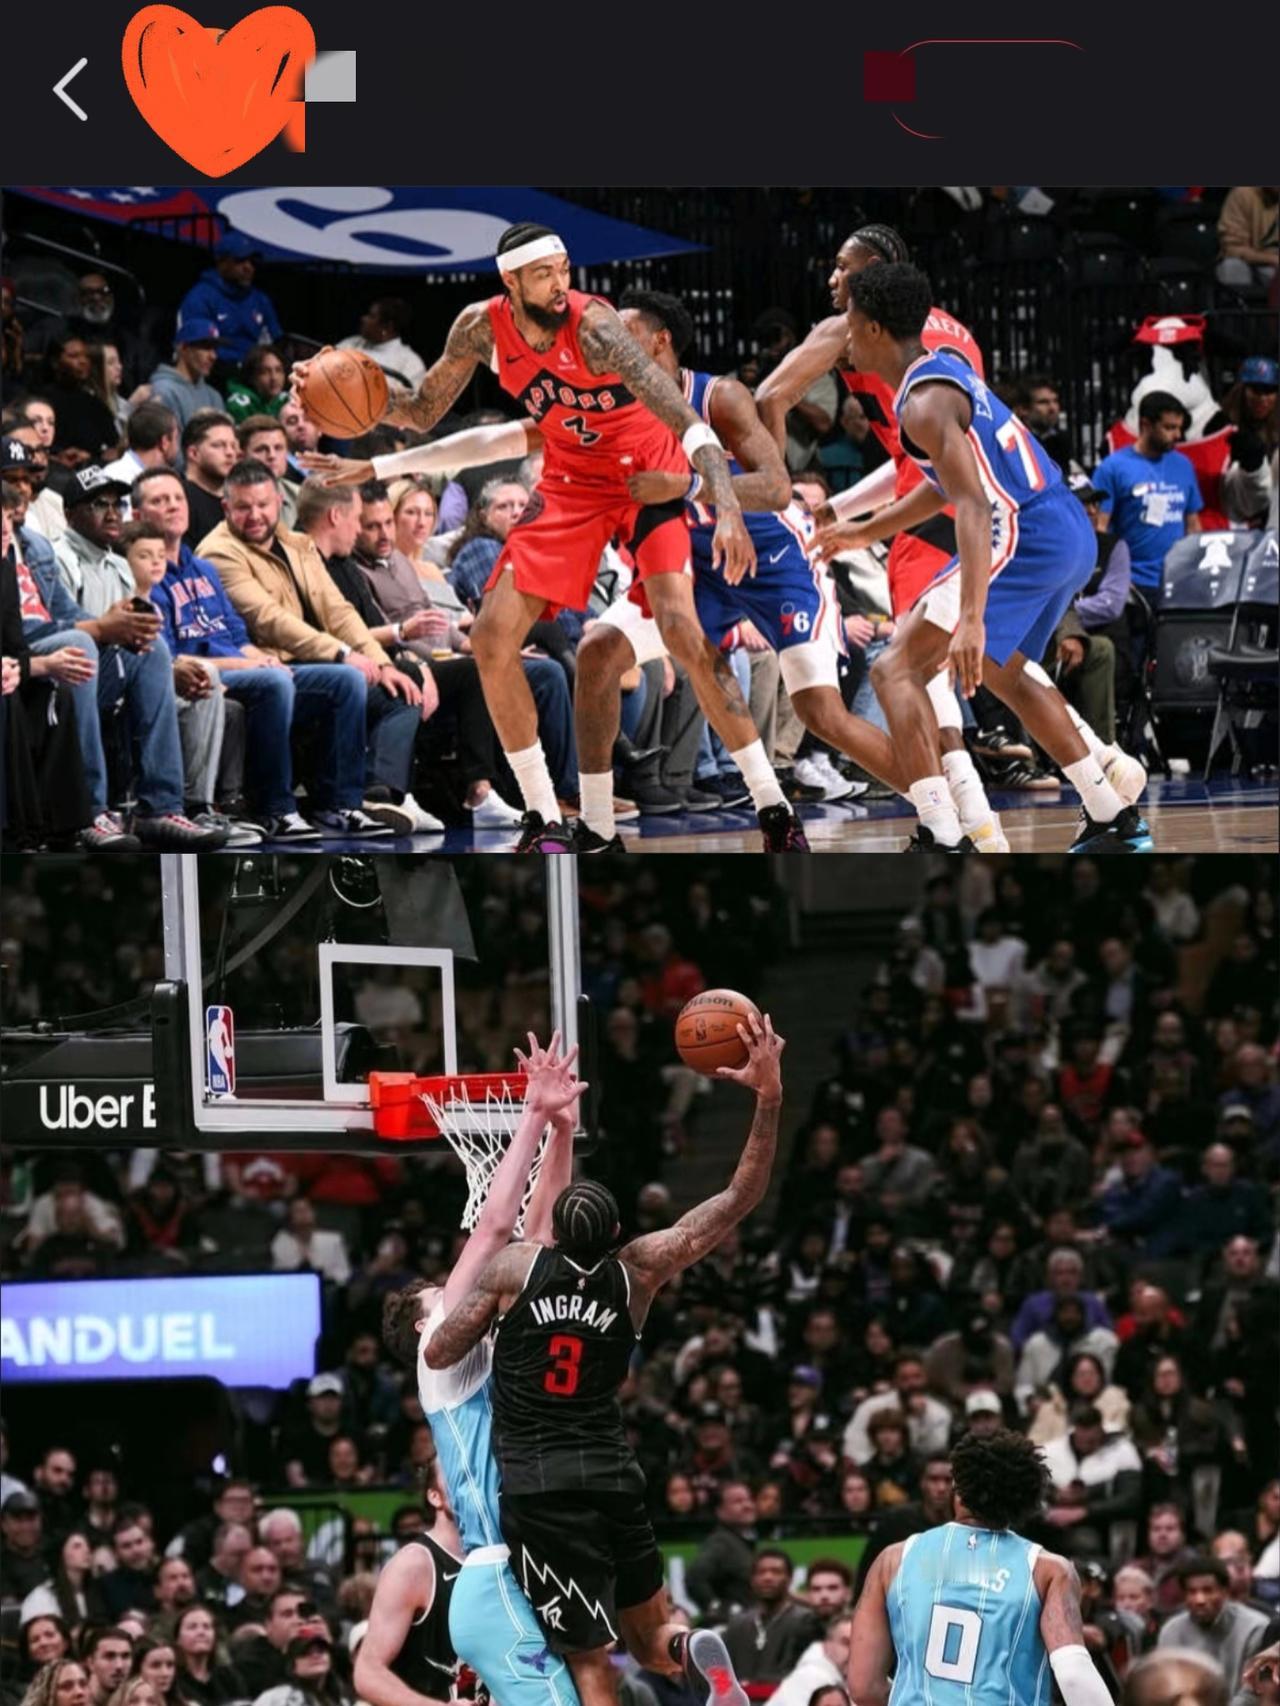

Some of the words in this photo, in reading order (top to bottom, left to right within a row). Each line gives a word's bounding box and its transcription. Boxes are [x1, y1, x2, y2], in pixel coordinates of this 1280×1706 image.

[562, 415, 603, 445] 3
[995, 414, 1046, 491] 7
[780, 611, 811, 636] 76
[40, 1085, 135, 1129] Uber
[530, 1295, 618, 1333] INGRAM
[1, 1312, 235, 1367] ANDUEL
[544, 1334, 584, 1397] 3
[924, 1603, 984, 1685] 0
